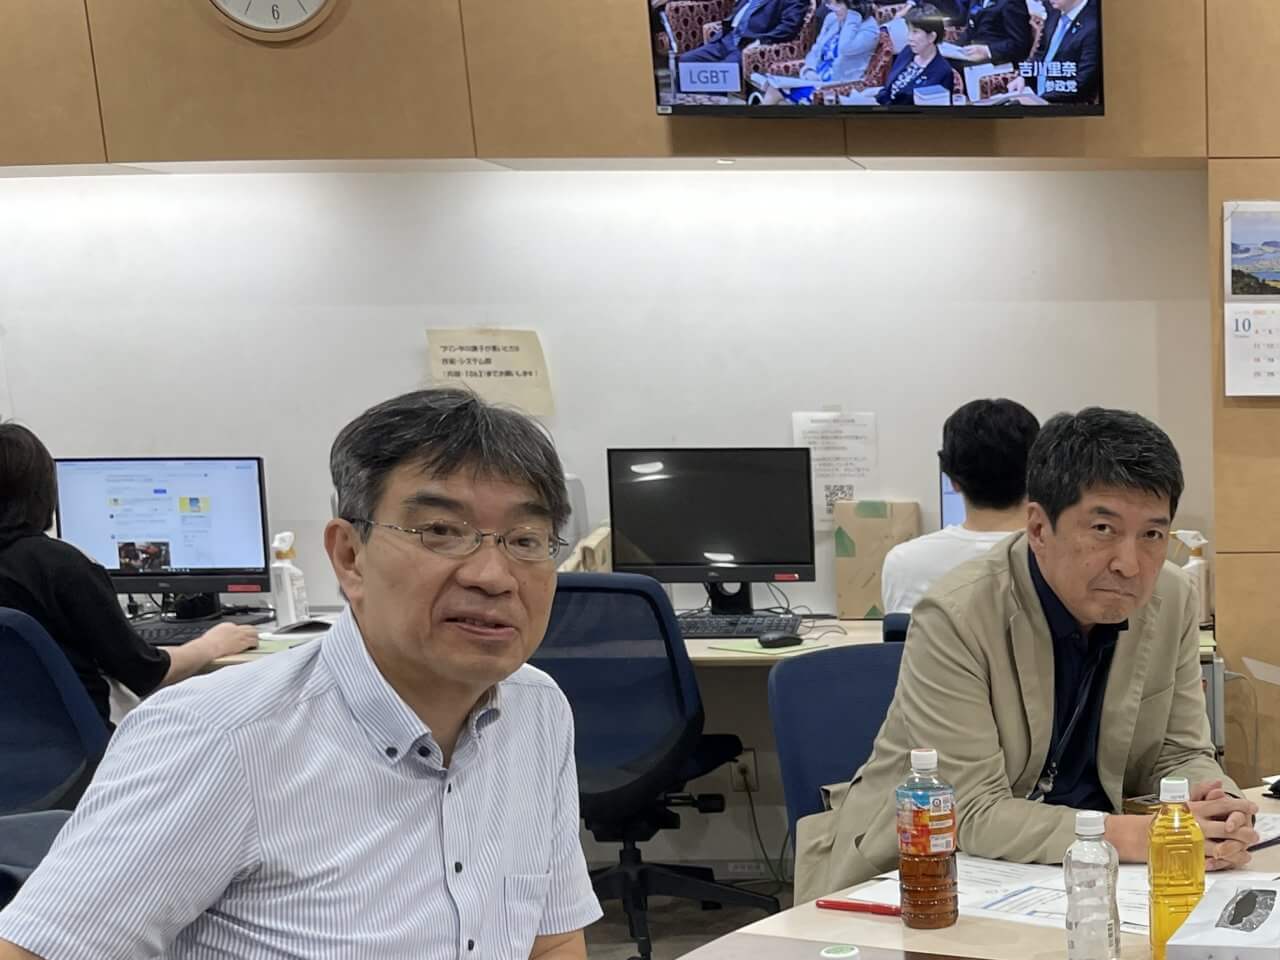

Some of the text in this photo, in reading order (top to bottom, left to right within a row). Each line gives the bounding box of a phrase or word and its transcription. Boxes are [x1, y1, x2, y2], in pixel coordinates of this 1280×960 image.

[271, 4, 280, 20] 6
[688, 68, 729, 86] LGBT
[1018, 61, 1077, 77] 吉川里奈
[1234, 318, 1251, 333] 10
